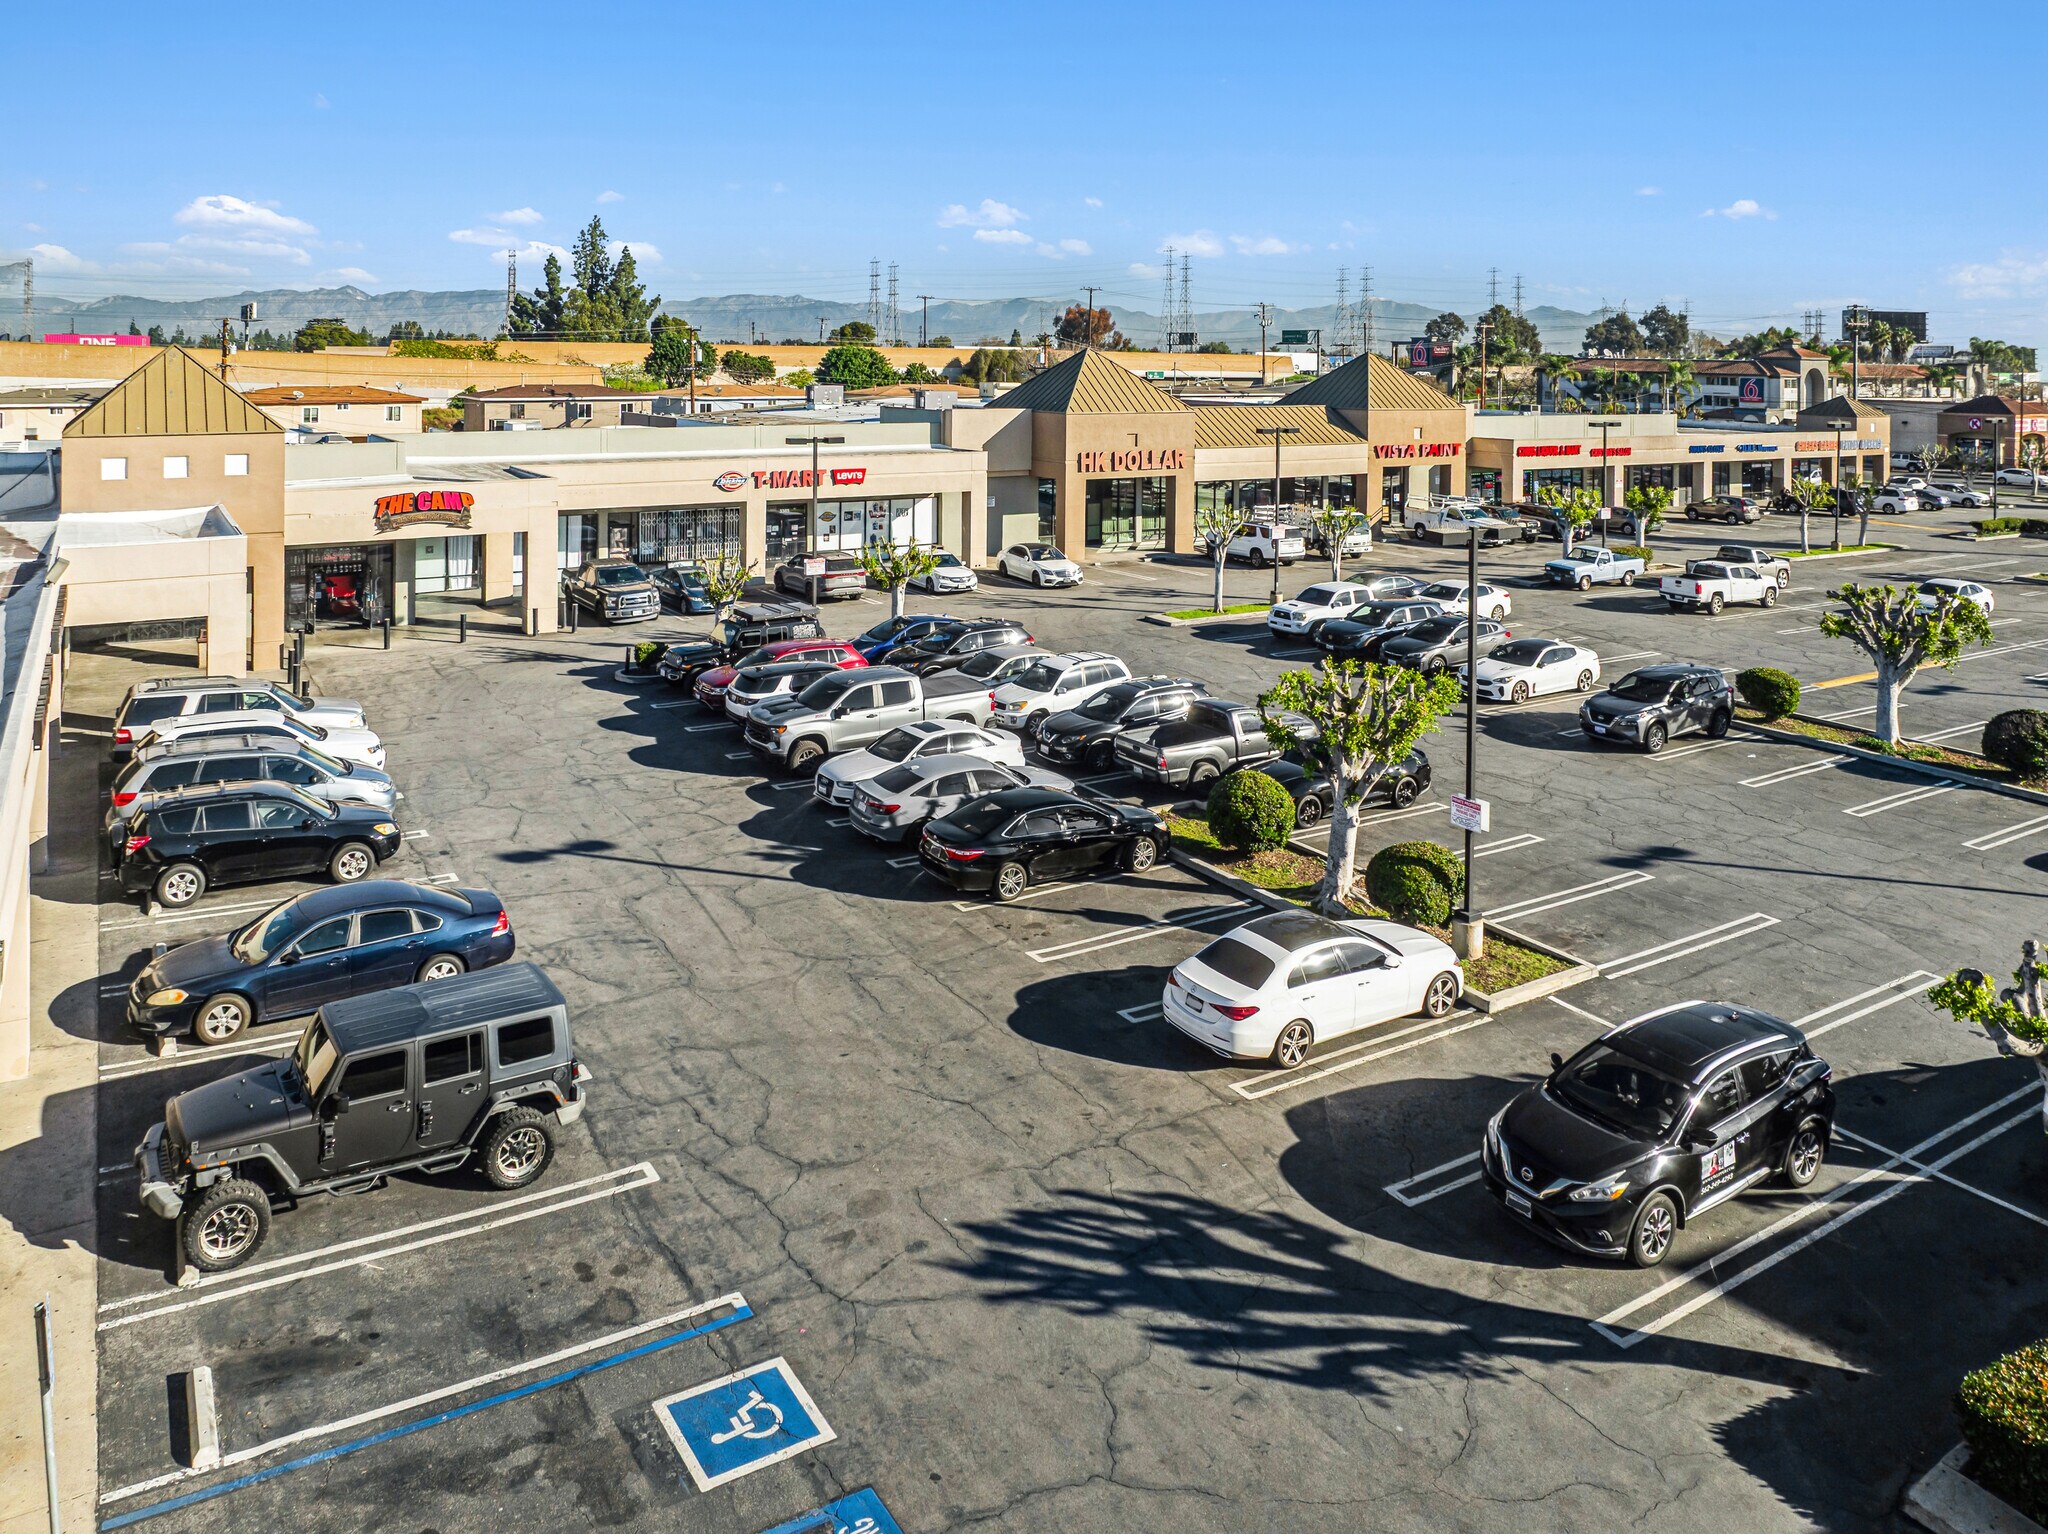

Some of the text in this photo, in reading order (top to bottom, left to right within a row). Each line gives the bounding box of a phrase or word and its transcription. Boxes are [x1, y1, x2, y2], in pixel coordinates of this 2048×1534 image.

[1413, 340, 1427, 362] 6
[1744, 378, 1758, 398] 6
[1078, 448, 1186, 473] HK DOLLAR
[1374, 443, 1461, 459] VISTA PAINT
[751, 469, 827, 489] T-MART
[376, 493, 415, 518] THE
[416, 490, 475, 511] CAMP
